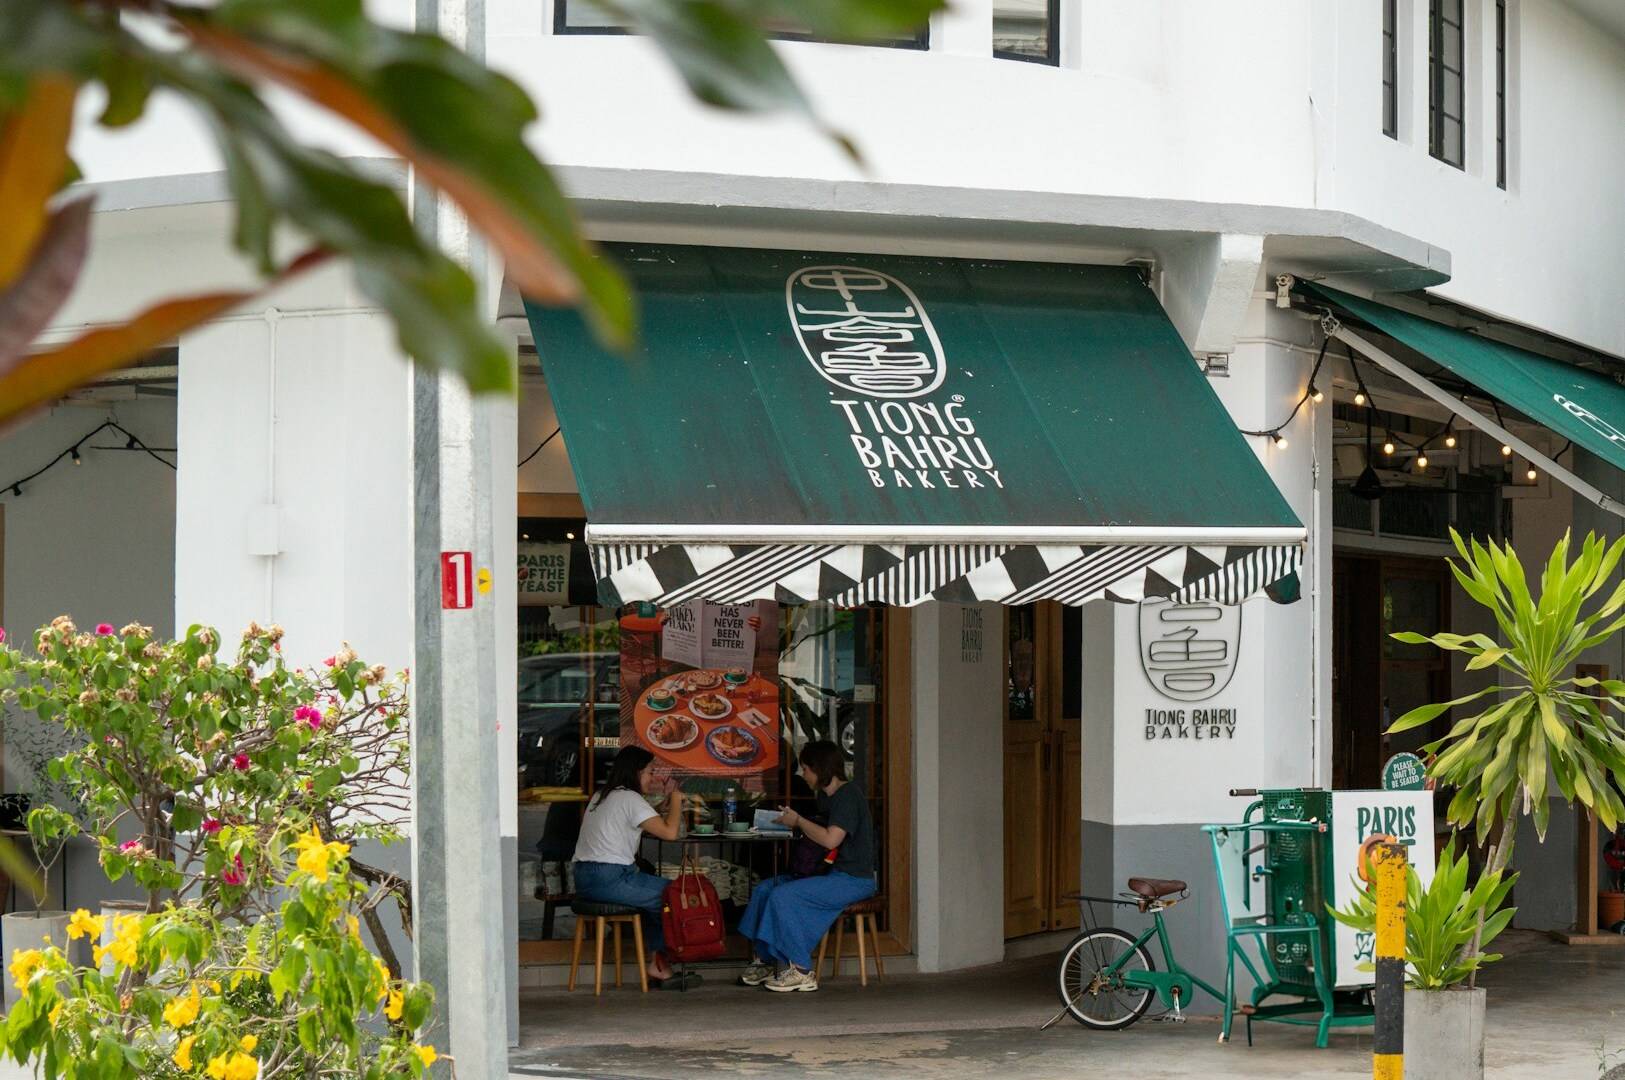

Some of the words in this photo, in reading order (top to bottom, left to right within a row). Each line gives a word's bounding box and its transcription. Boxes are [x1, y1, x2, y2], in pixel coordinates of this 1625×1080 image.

[830, 400, 975, 435] TIONG
[850, 434, 993, 470] BAHRU
[867, 469, 1004, 488] BAKERY
[518, 554, 565, 567] PARIS
[448, 553, 466, 608] 1
[518, 580, 565, 592] YEAST
[720, 607, 740, 618] HAS
[714, 618, 744, 629] NEVER
[717, 628, 740, 639] BEEN
[1145, 709, 1185, 726] TIONG
[1192, 708, 1237, 726] BAHRU
[1145, 725, 1236, 740] BAKERY
[1393, 760, 1413, 772] PLEASE
[1392, 770, 1407, 780] WAIT
[1408, 768, 1417, 776] TO
[1391, 780, 1400, 789] BE
[1400, 775, 1420, 787] SEATED
[1357, 805, 1416, 844] PARIS
